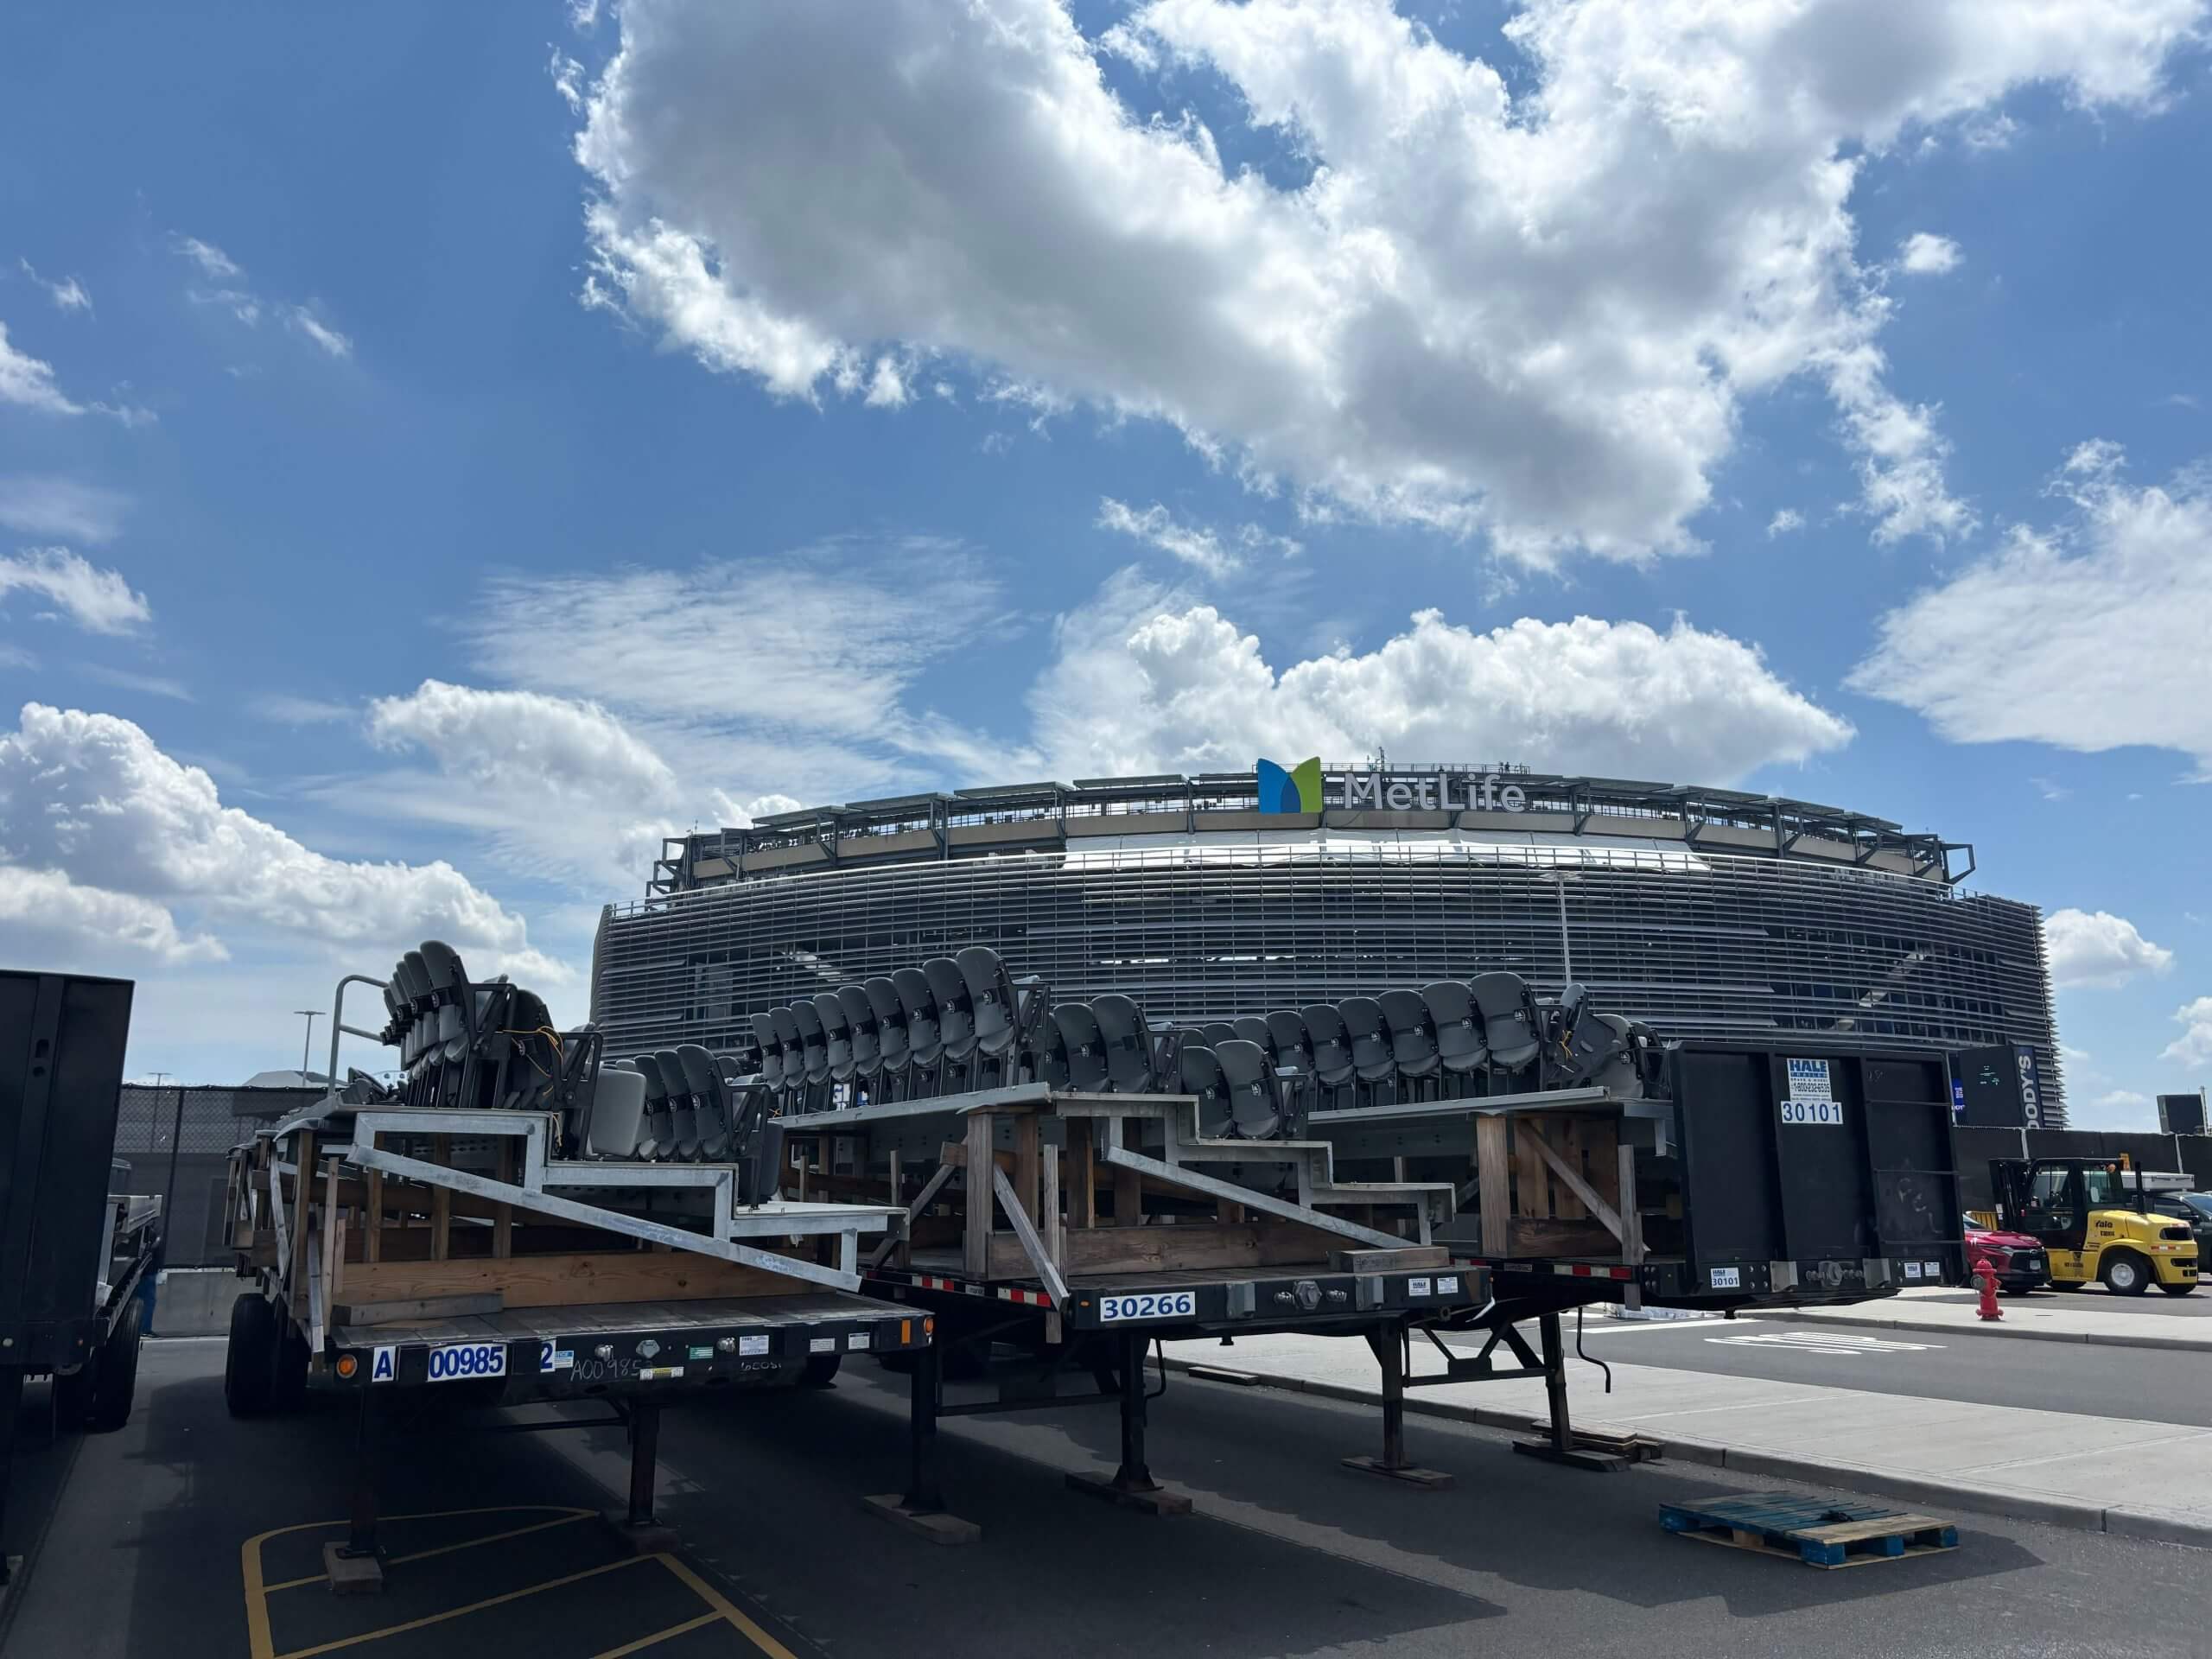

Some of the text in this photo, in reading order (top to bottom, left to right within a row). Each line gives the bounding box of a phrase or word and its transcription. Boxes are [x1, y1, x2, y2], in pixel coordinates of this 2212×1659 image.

[1344, 772, 1526, 812] MetLife
[1789, 1059, 1827, 1072] HALE
[2018, 1055, 2040, 1129] OODY'S
[1783, 1103, 1840, 1122] 30101
[1712, 1277, 1738, 1286] 30101
[1103, 1294, 1191, 1319] 30266
[373, 1351, 393, 1379] A
[429, 1345, 504, 1379] 00985
[540, 1342, 554, 1370] 2
